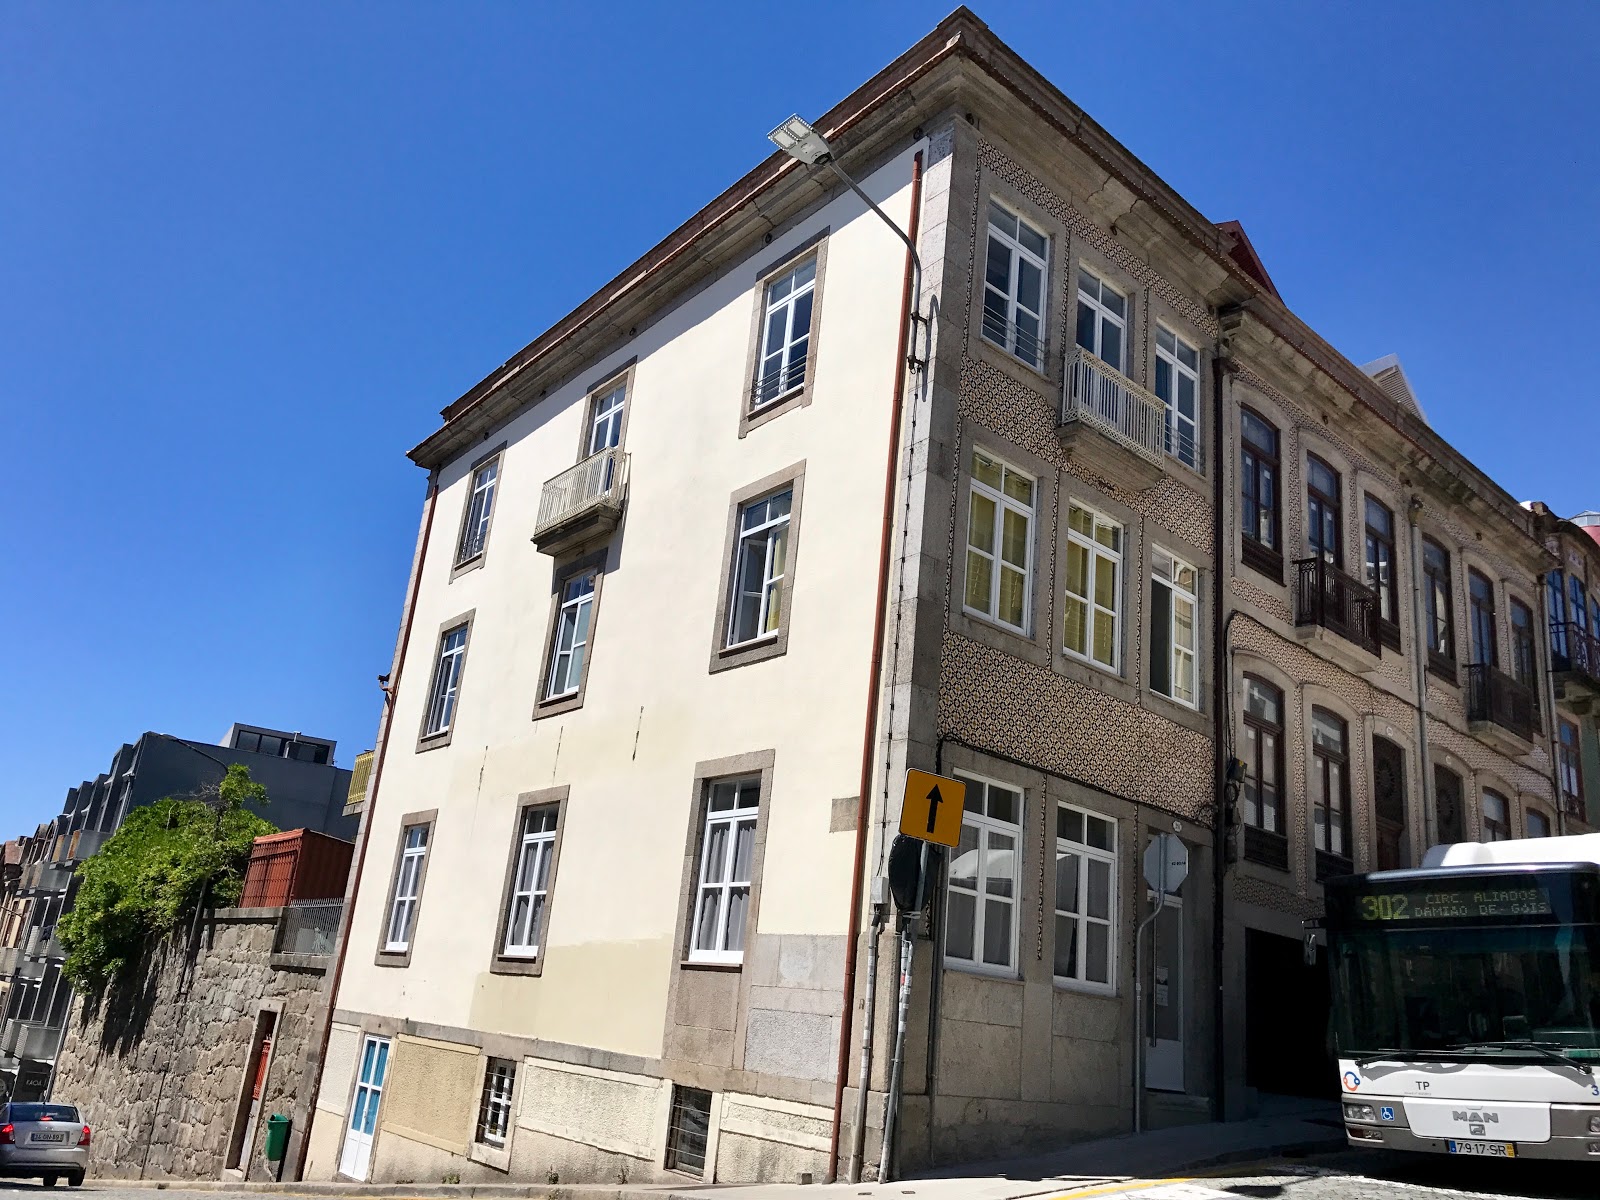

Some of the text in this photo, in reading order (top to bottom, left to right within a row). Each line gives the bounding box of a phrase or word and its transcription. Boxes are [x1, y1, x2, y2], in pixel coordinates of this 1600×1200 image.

[1473, 890, 1538, 903] ALIADOS
[1361, 894, 1410, 920] 302
[1479, 904, 1497, 915] DE
[1452, 1110, 1499, 1123] MAN
